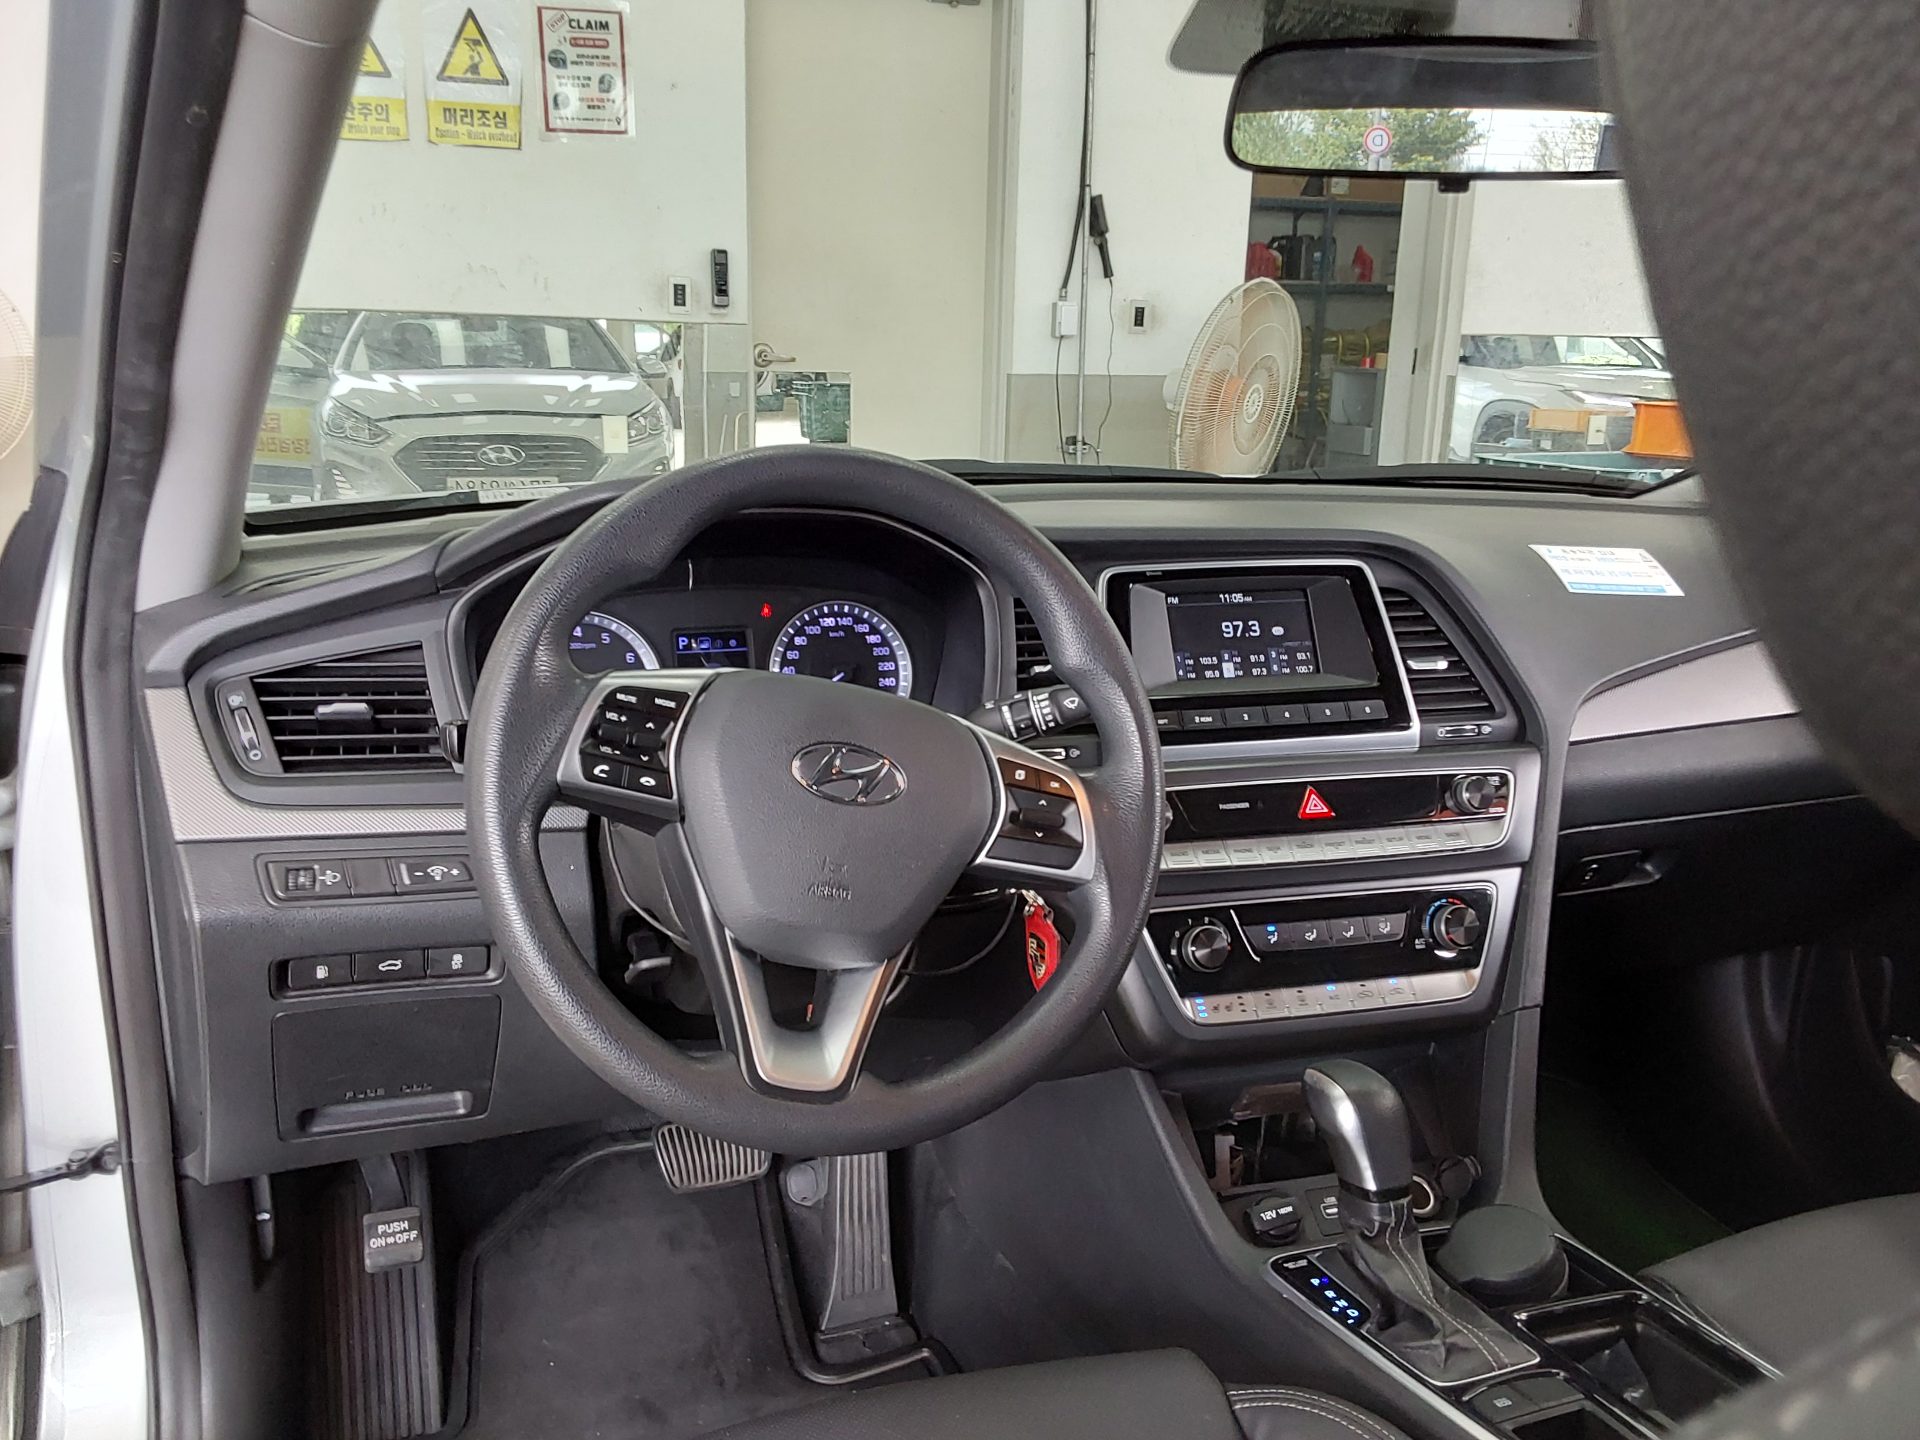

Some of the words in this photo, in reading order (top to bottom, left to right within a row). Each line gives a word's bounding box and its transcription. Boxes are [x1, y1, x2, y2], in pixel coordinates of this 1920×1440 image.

[568, 18, 610, 32] CLAIM
[442, 107, 509, 129] 머리조심
[819, 617, 836, 627] 120
[836, 617, 853, 626] 140
[572, 625, 583, 637] 4
[804, 625, 822, 635] 100
[853, 623, 870, 633] 160
[1221, 620, 1261, 638] 97.3
[600, 632, 611, 644] 5
[678, 636, 689, 650] P
[793, 636, 807, 646] 80
[865, 634, 882, 644] 180
[786, 650, 800, 660] 60
[872, 646, 890, 656] 200
[625, 652, 636, 664] 6
[782, 665, 796, 675] 40
[878, 661, 896, 671] 220
[878, 676, 897, 687] 240
[1260, 1209, 1277, 1221] 12V
[377, 1220, 409, 1235] PUSH
[1310, 1277, 1321, 1287] P
[1324, 1289, 1337, 1299] R
[1334, 1298, 1349, 1308] N
[1346, 1308, 1359, 1318] D
